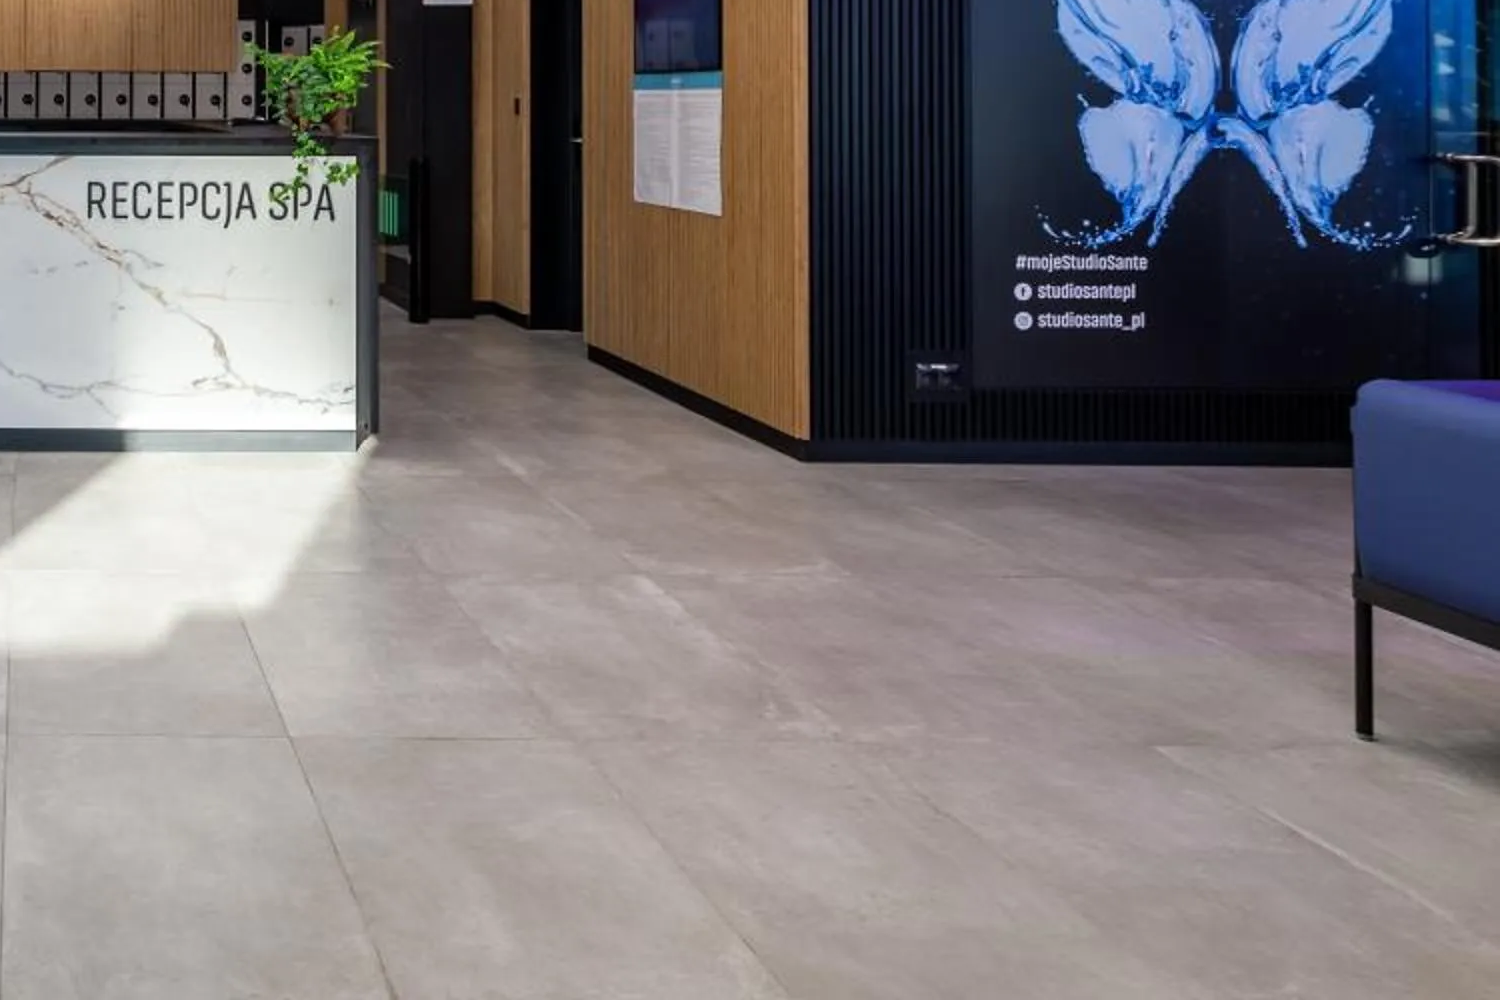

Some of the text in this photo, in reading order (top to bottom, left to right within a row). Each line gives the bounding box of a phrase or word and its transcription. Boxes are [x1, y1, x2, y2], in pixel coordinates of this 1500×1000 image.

[87, 181, 336, 229] RECEPCJA SPA
[1015, 254, 1148, 272] #mojeStudioSante
[1037, 283, 1136, 302] studiosantepl
[1037, 312, 1145, 331] studiosante_pl
